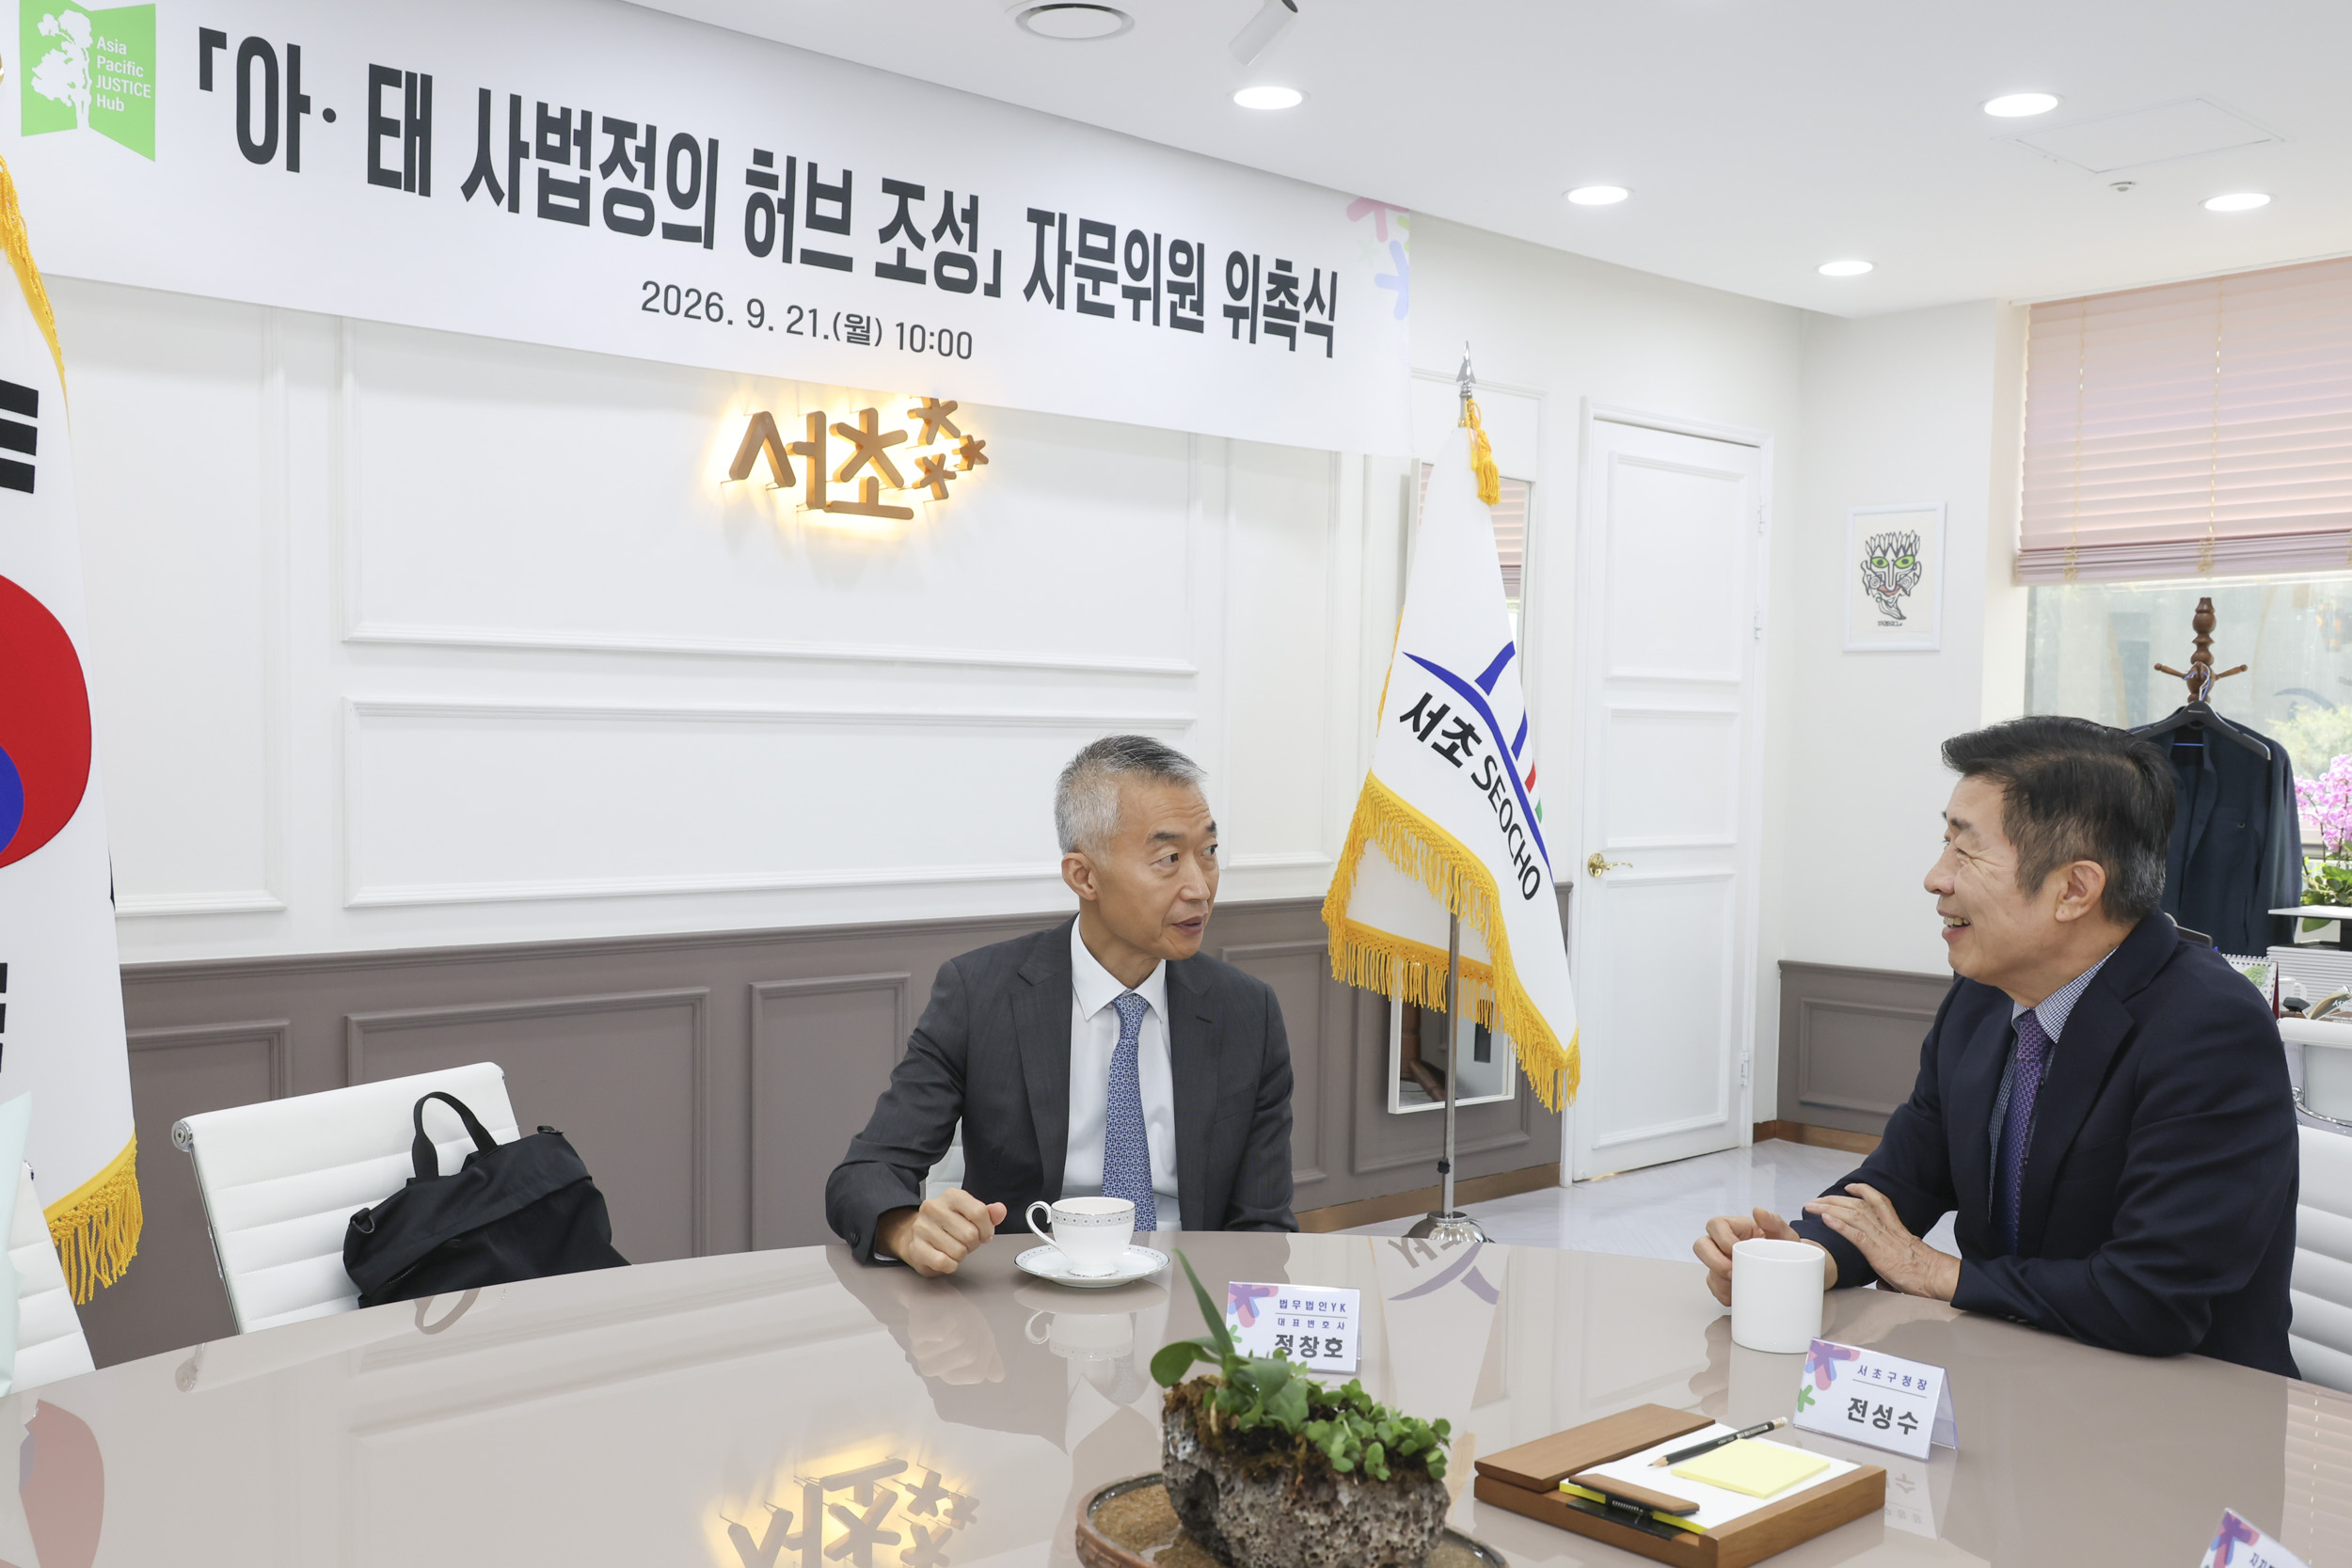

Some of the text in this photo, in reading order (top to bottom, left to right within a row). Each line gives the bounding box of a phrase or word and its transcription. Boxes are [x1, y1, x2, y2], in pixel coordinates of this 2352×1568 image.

[96, 36, 128, 55] Asia
[96, 55, 145, 78] Pacific
[96, 74, 152, 99] JUSTICE
[96, 93, 126, 112] Hub
[460, 87, 720, 250] 사법정의
[744, 148, 853, 273] 허브
[874, 177, 1002, 299] 조성」
[1023, 207, 1206, 335] 자문위원
[1222, 250, 1338, 358] 위촉식
[641, 280, 734, 325] 2026.
[746, 298, 774, 331] 9.
[896, 322, 973, 359] 10:00
[728, 407, 914, 520] 서초
[1399, 691, 1541, 900] 서초 SEOCHO
[1279, 1299, 1346, 1312] 법무법인YK
[1275, 1334, 1343, 1358] 정창호
[1857, 1365, 1928, 1390] 서초구청장
[1847, 1397, 1919, 1435] 전성수
